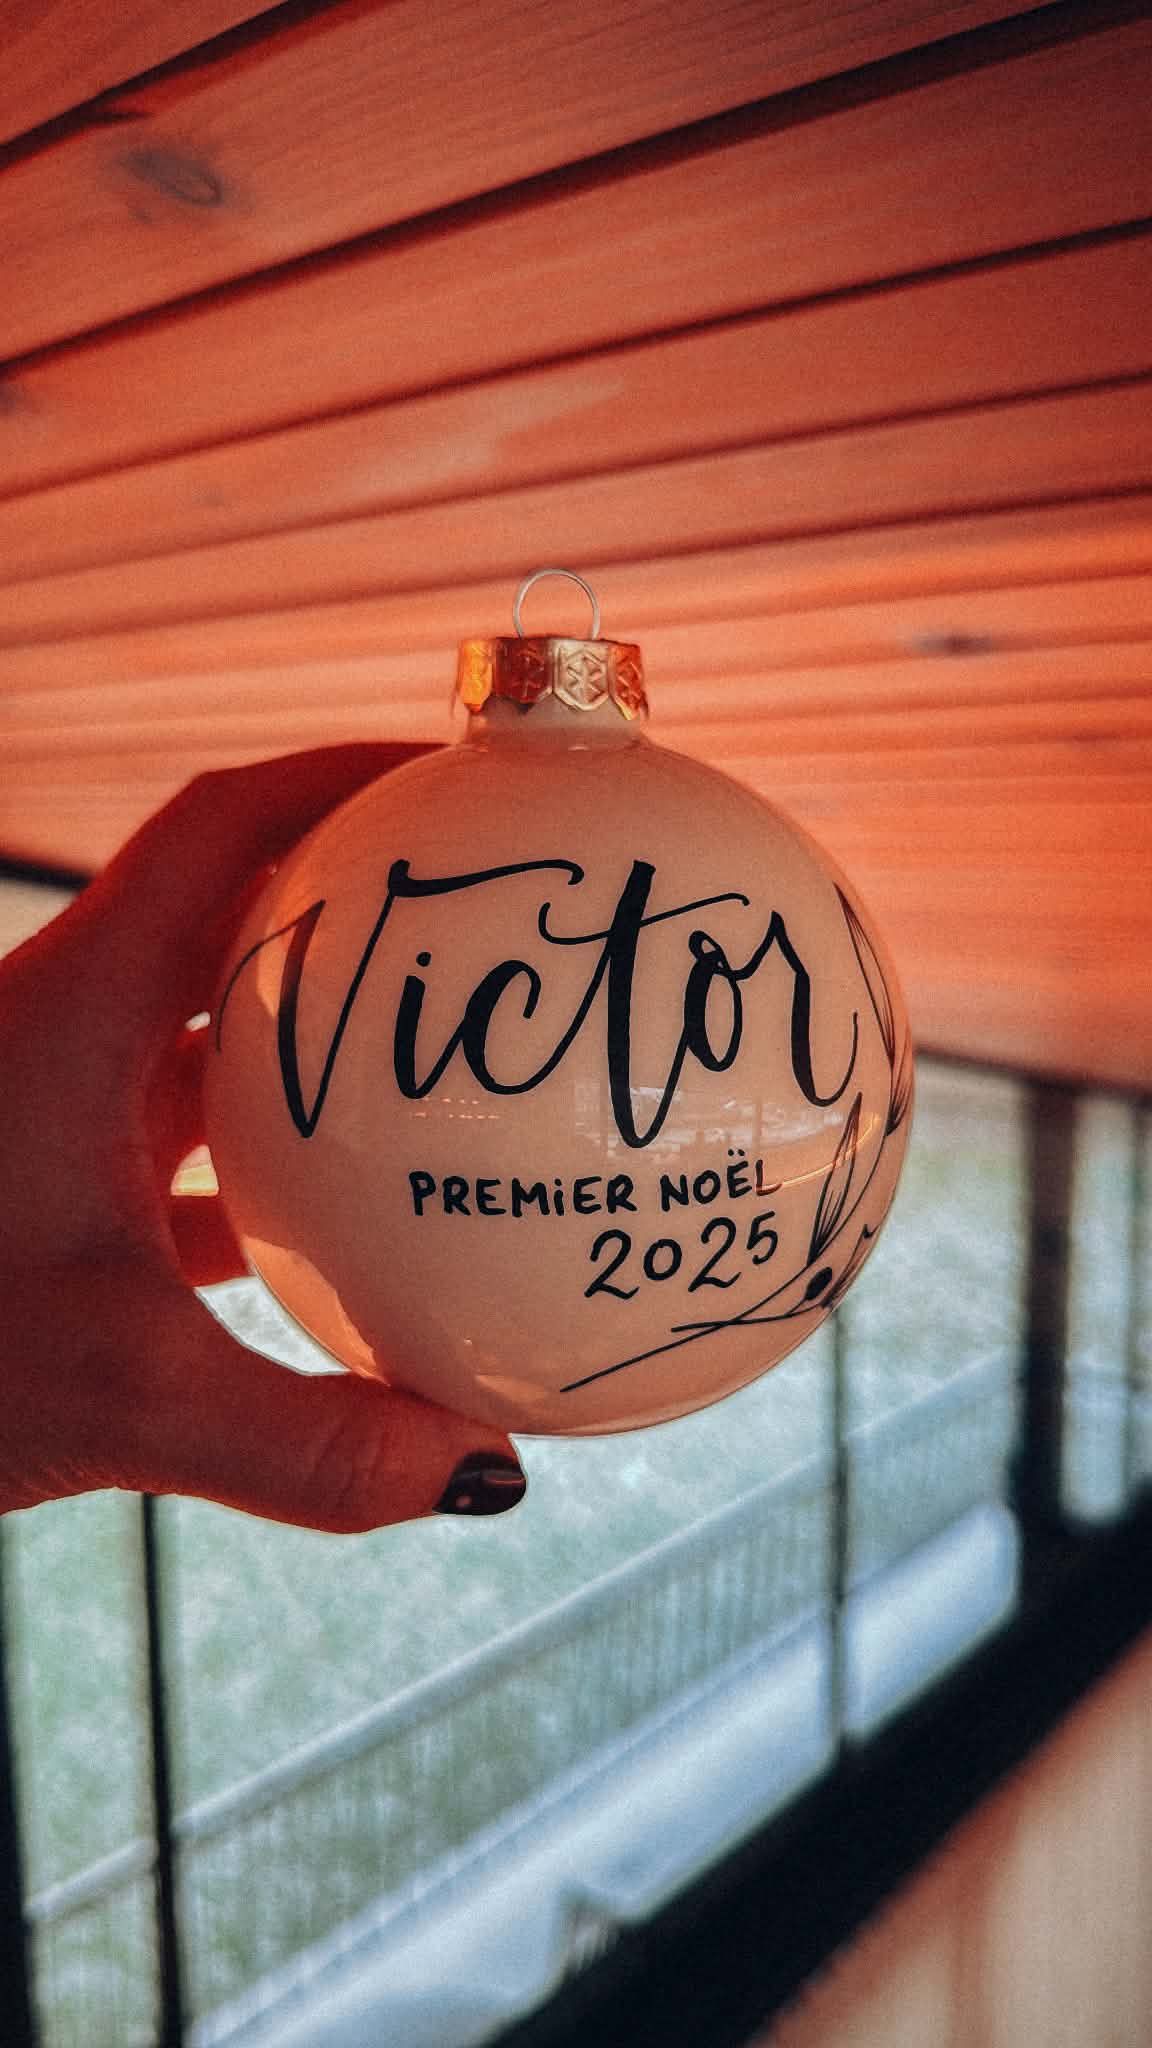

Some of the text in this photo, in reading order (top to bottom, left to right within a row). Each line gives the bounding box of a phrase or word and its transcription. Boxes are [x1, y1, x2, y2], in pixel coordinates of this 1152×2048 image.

[217, 859, 858, 1148] Victor
[660, 1149, 781, 1211] NOËL
[584, 1211, 778, 1299] 2025
